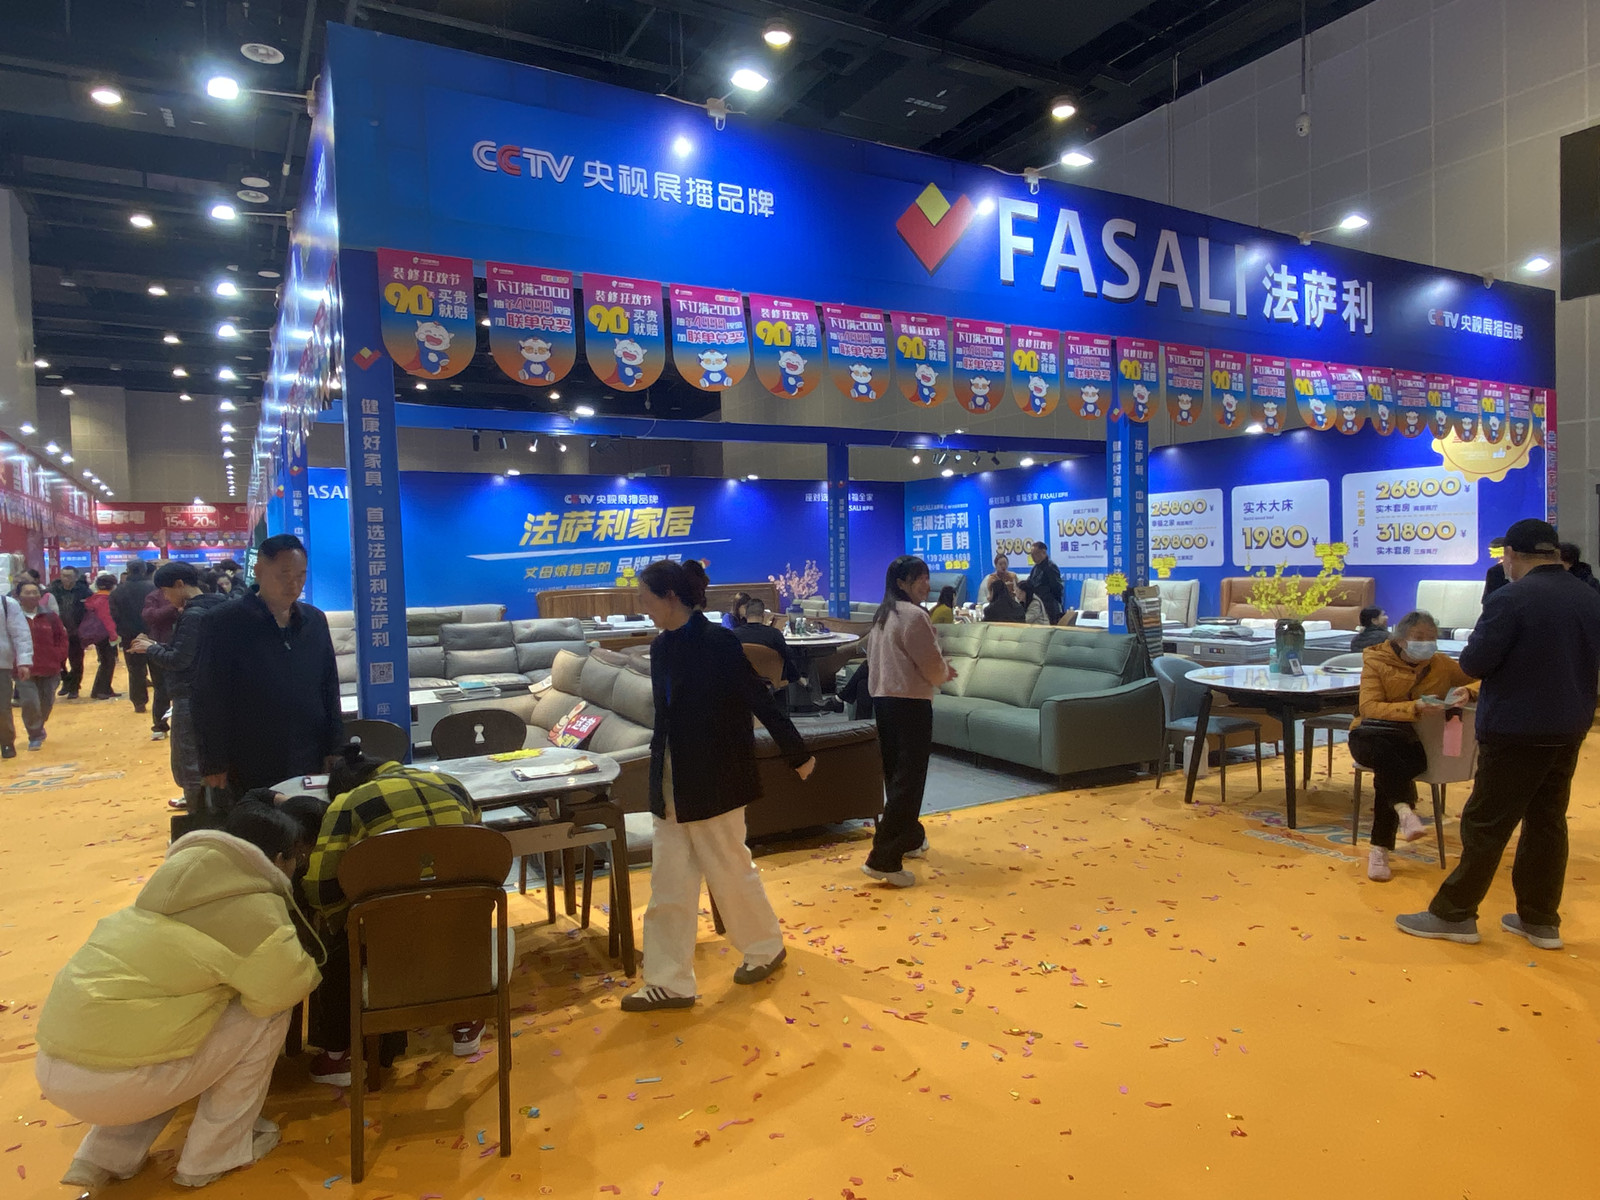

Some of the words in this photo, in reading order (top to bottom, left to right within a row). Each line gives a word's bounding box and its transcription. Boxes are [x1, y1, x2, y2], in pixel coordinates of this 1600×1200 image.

[472, 140, 575, 183] CCTV
[583, 160, 775, 218] 央视展播品牌
[998, 196, 1248, 318] FASALI
[1262, 262, 1374, 335] 法萨利
[393, 266, 461, 286] 装修狂欢节
[438, 288, 468, 305] 买贵
[493, 279, 570, 299] 下订满2000
[595, 289, 652, 306] 装修狂欢节
[438, 303, 468, 320] 就赔
[633, 309, 658, 323] 买贵
[676, 299, 741, 316] 下订满2000
[633, 322, 659, 337] 就赔
[1427, 307, 1458, 330] CCTV
[1460, 313, 1523, 341] 央视展播品牌
[1375, 476, 1461, 500] 26800
[564, 494, 595, 505] CCTV
[596, 494, 659, 505] 央视展播品牌
[1151, 497, 1207, 517] 25800
[1243, 499, 1293, 514] 实木大床
[1376, 503, 1410, 514] 实木套房
[519, 505, 696, 546] 法萨利家居
[912, 511, 969, 532] 深圳法萨利
[1242, 525, 1309, 550] 1980
[1376, 521, 1456, 542] 31800
[912, 531, 970, 552] 工厂直销
[996, 537, 1034, 556] 3980
[1151, 533, 1208, 550] 29800
[1376, 546, 1411, 555] 实木套房
